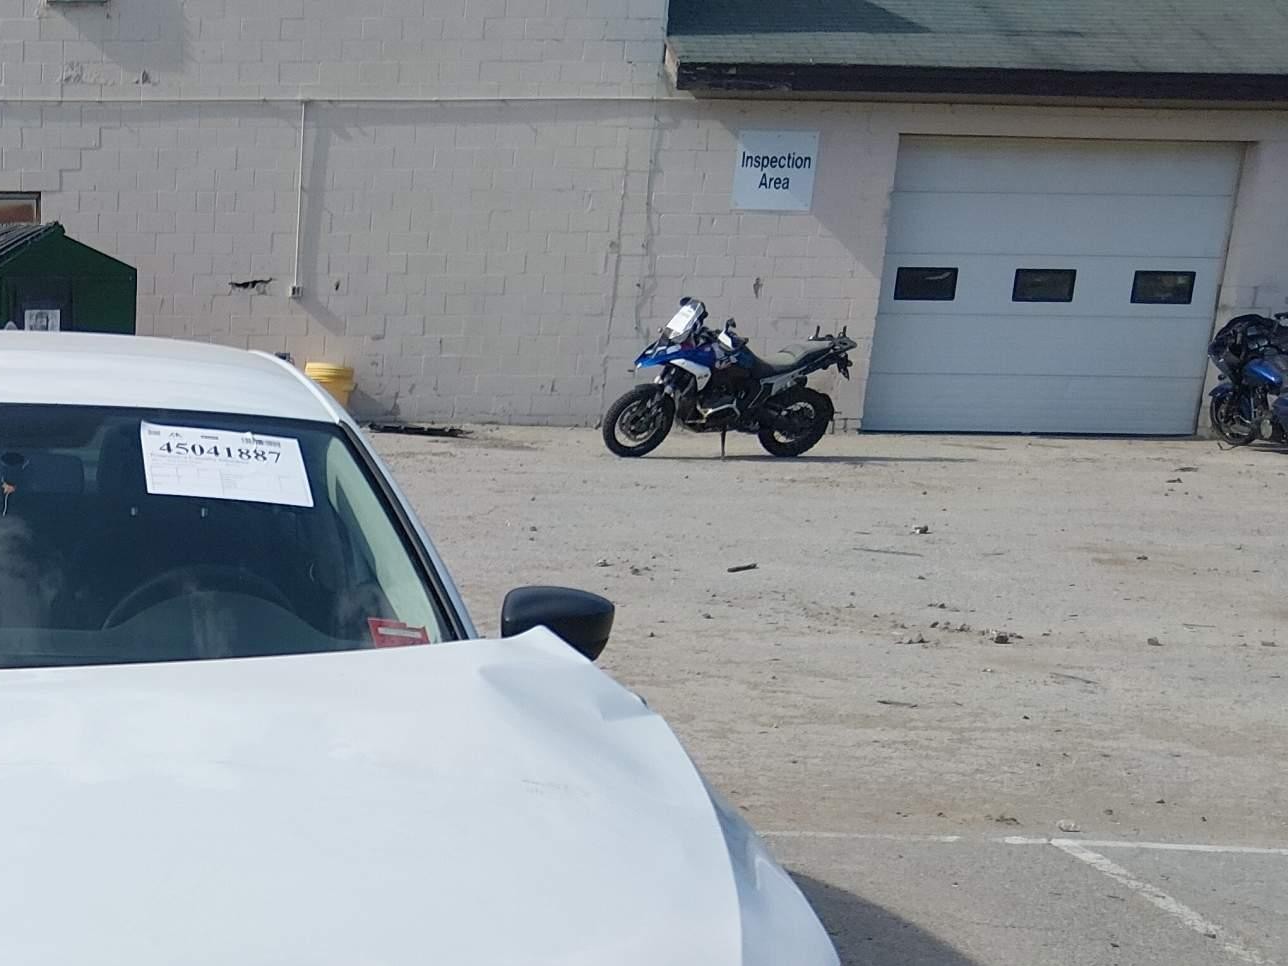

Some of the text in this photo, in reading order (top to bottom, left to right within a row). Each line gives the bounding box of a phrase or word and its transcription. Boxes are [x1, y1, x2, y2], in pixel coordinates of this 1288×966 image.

[741, 150, 812, 172] Inspection
[758, 172, 790, 190] Area
[159, 441, 282, 463] 45041887
